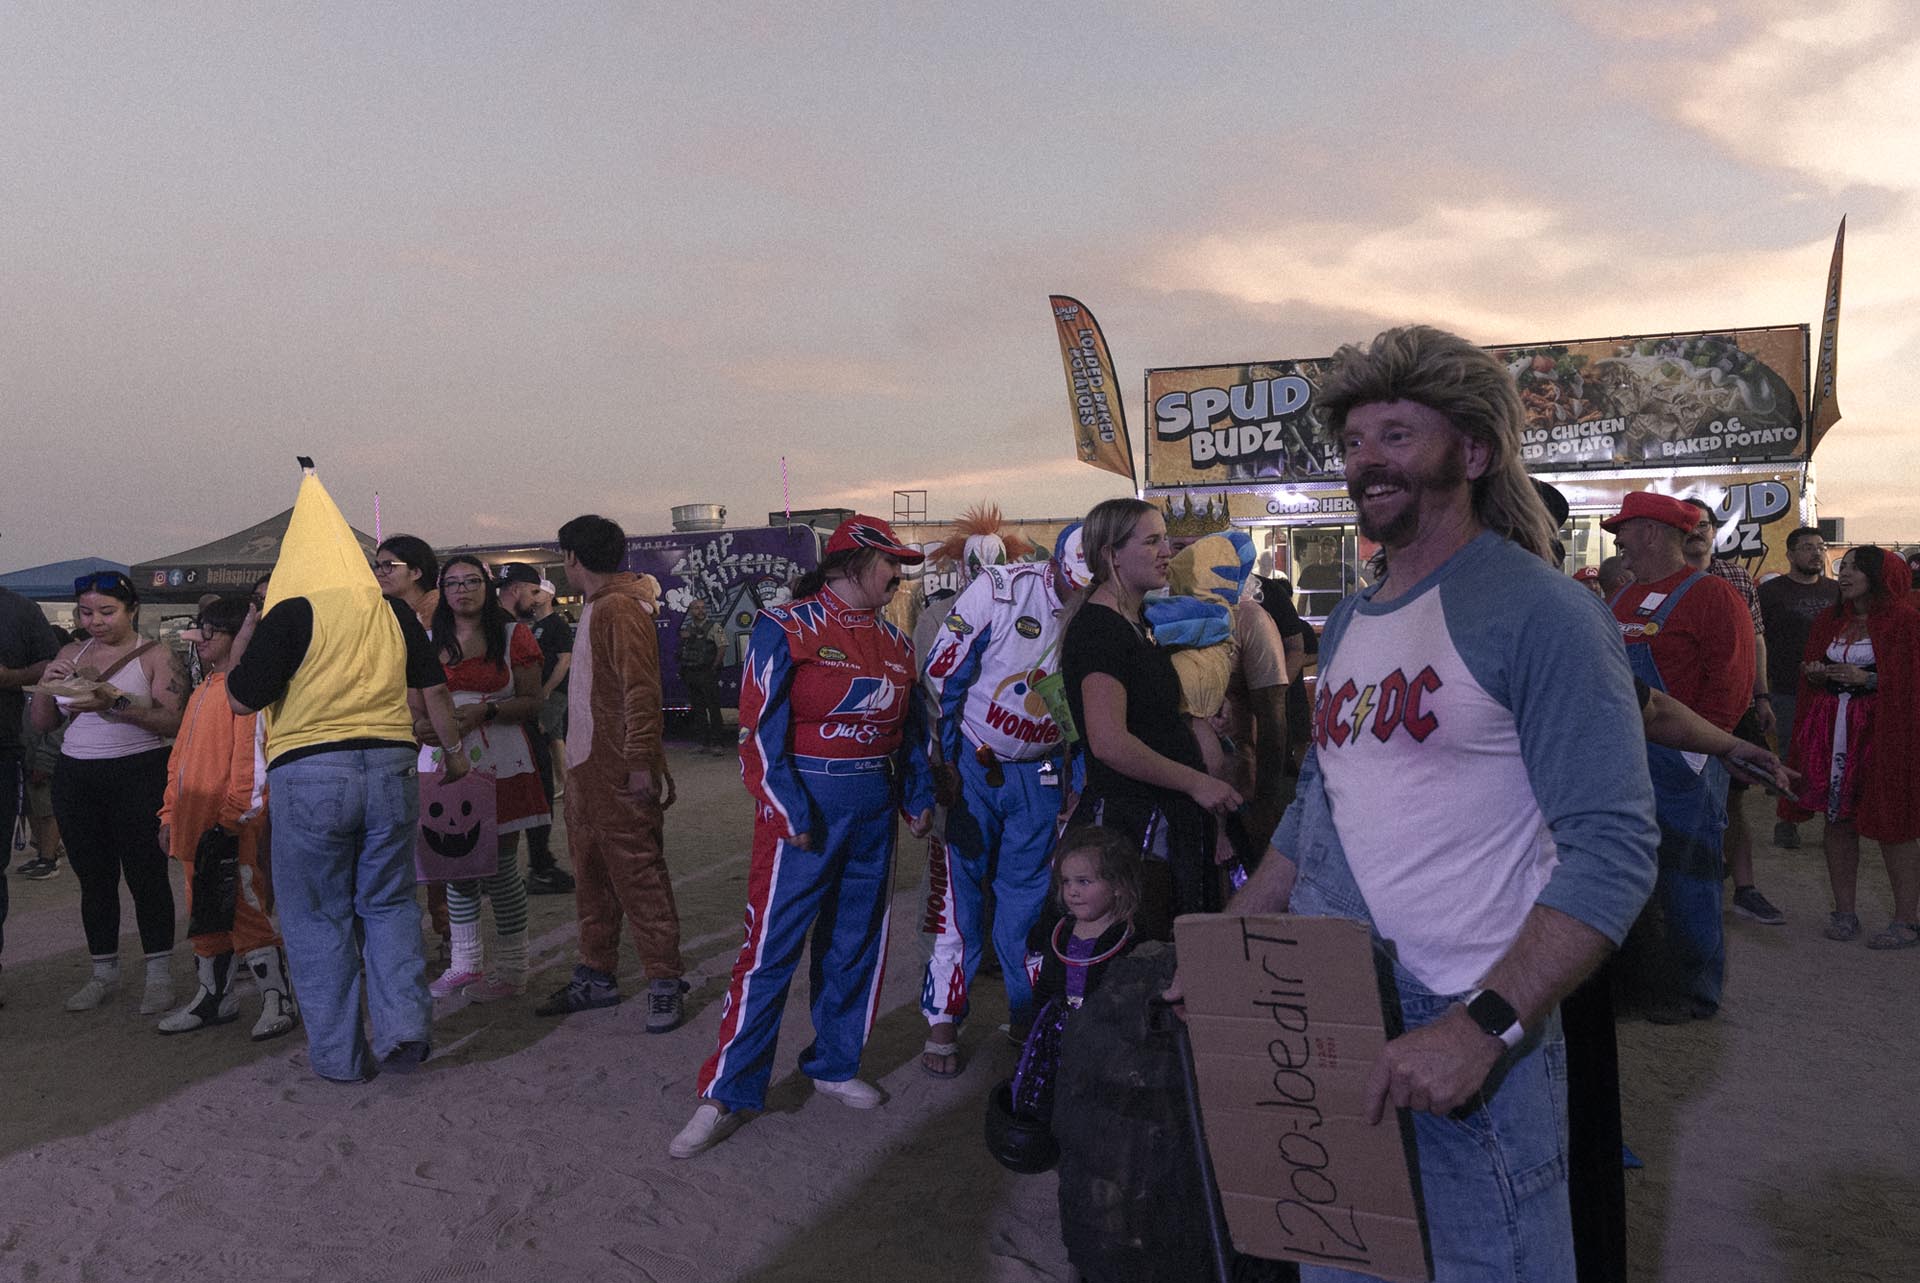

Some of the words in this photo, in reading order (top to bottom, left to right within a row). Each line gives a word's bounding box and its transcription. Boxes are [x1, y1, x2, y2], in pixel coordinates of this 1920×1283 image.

[1068, 347, 1096, 427] POTATOES
[1078, 329, 1104, 388] LOADED
[1092, 392, 1116, 444] BAKED
[1156, 375, 1311, 434] SPUD
[1550, 417, 1625, 440] CHICKEN
[1709, 416, 1746, 434] O.G.
[1191, 420, 1284, 462] BUDZ
[1546, 435, 1615, 457] POTATO
[1661, 435, 1722, 457] BAKED
[1724, 426, 1798, 449] POTATO
[1266, 497, 1320, 514] ORDER
[818, 721, 857, 741] Old
[986, 701, 1061, 744] Wonde
